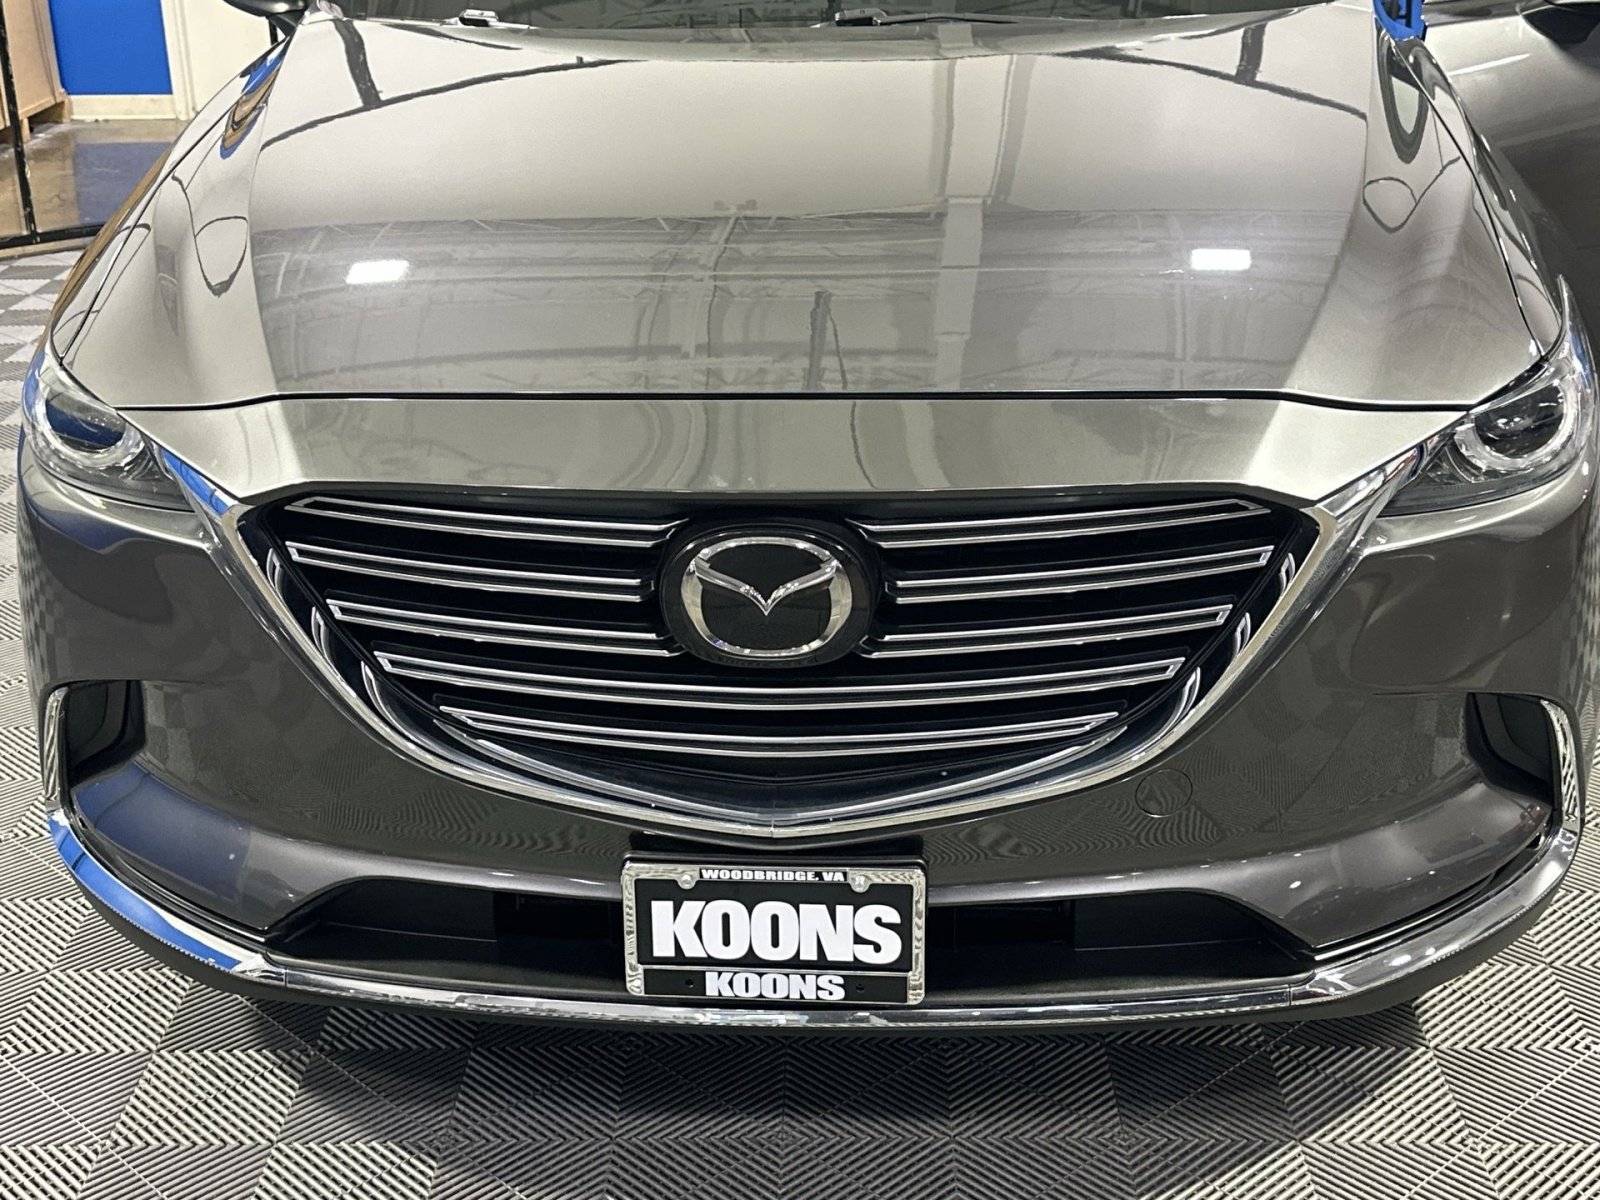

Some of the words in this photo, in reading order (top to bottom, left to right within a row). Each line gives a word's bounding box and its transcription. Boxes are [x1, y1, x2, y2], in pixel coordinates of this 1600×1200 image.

[822, 871, 845, 882] VA
[651, 899, 902, 964] KOONS
[705, 971, 845, 1000] KOONS
